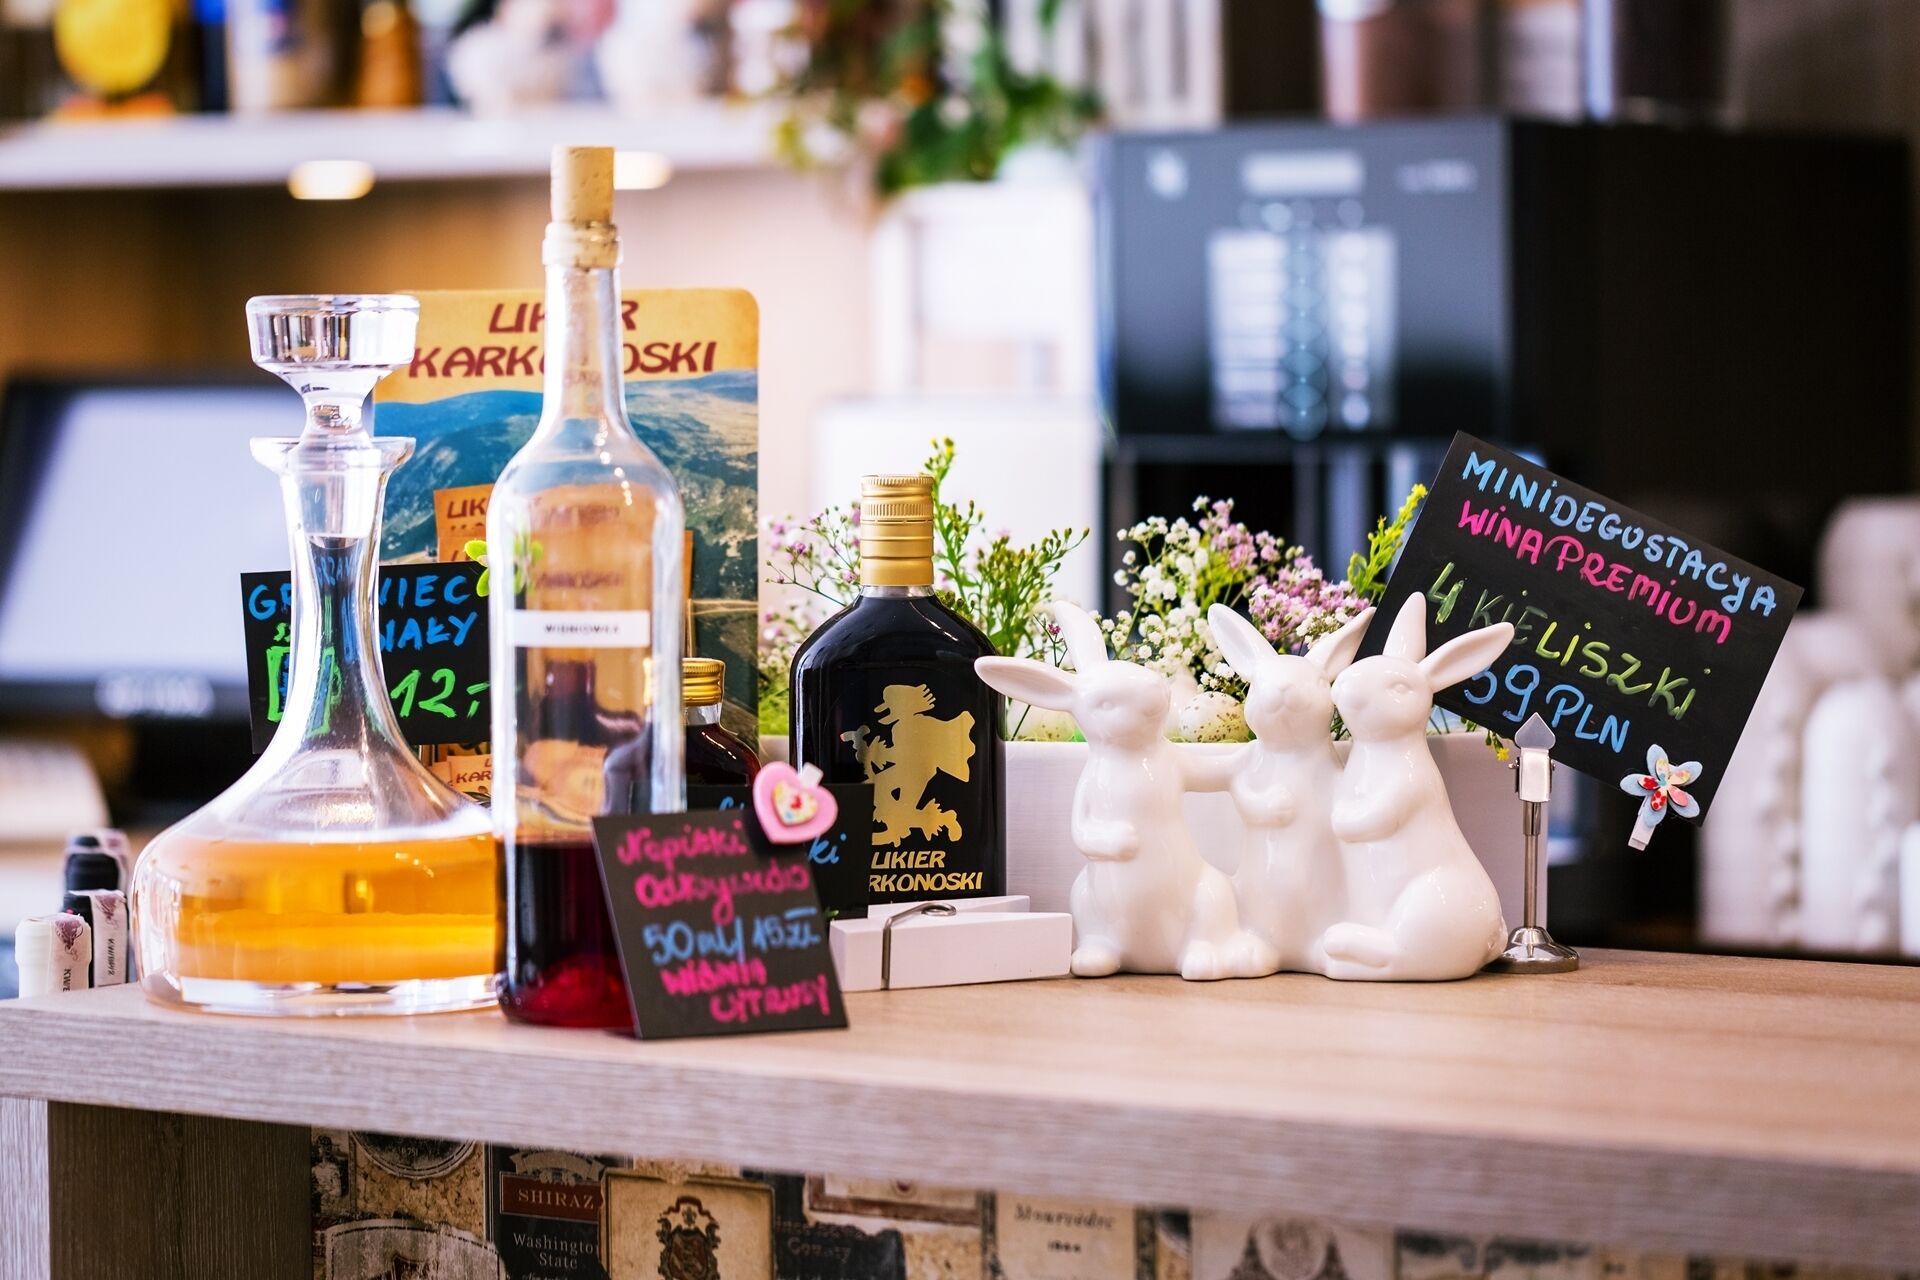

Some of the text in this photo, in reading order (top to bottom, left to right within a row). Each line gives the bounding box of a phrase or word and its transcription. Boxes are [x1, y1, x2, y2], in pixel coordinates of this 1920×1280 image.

[1426, 561, 1466, 625] 4
[1543, 535, 1733, 645] PREMIUM
[1546, 684, 1631, 754] PLN
[871, 850, 946, 869] LIKIER
[868, 872, 984, 892] RKONOSKI
[518, 1188, 594, 1210] SHIRAZ
[513, 1232, 598, 1256] Washingto
[539, 1252, 578, 1270] State
